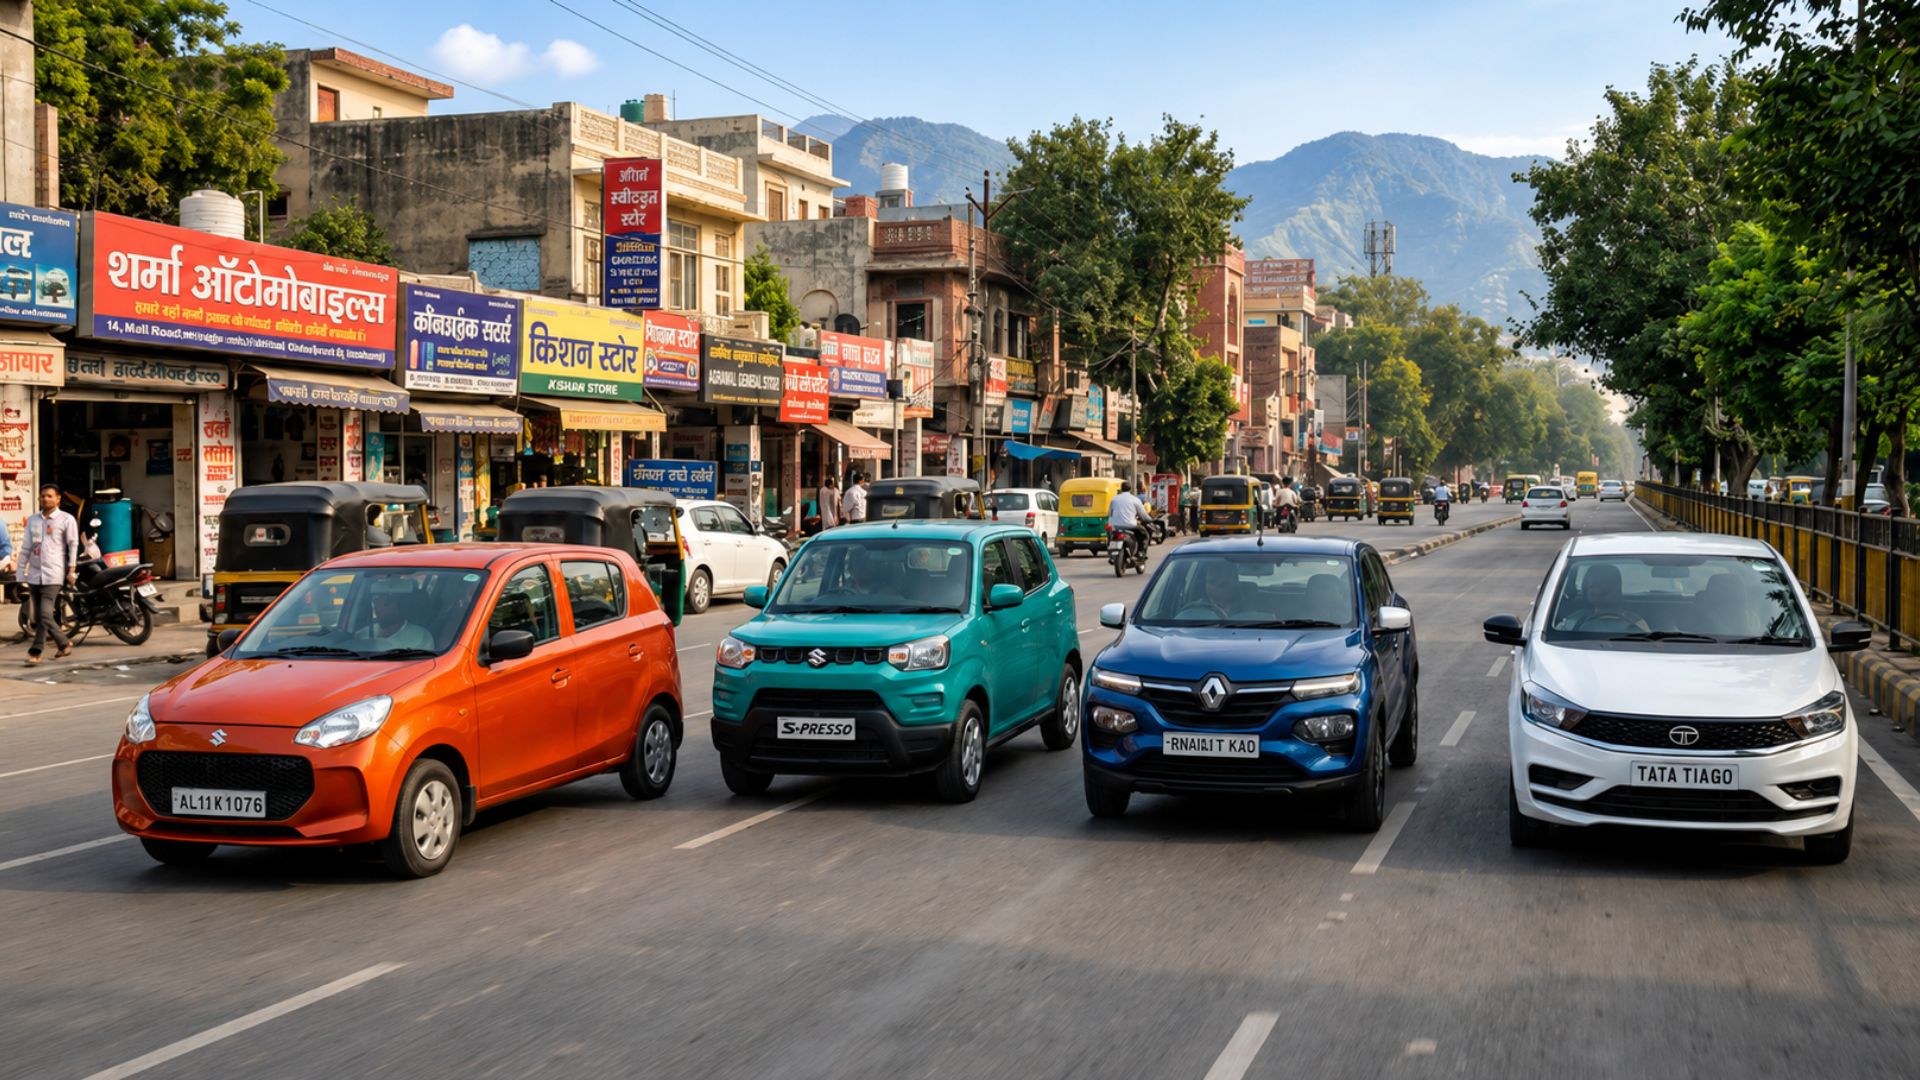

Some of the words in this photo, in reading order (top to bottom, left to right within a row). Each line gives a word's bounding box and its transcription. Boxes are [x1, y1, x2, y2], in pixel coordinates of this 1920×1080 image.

[108, 245, 183, 295] शर्मा
[191, 256, 387, 324] ऑटोमोबाइल्स
[529, 321, 594, 369] किशन
[598, 334, 639, 374] स्टोर
[1637, 766, 1677, 783] TATA
[1683, 768, 1733, 784] TIAGO
[180, 794, 263, 813] AL11K1076
